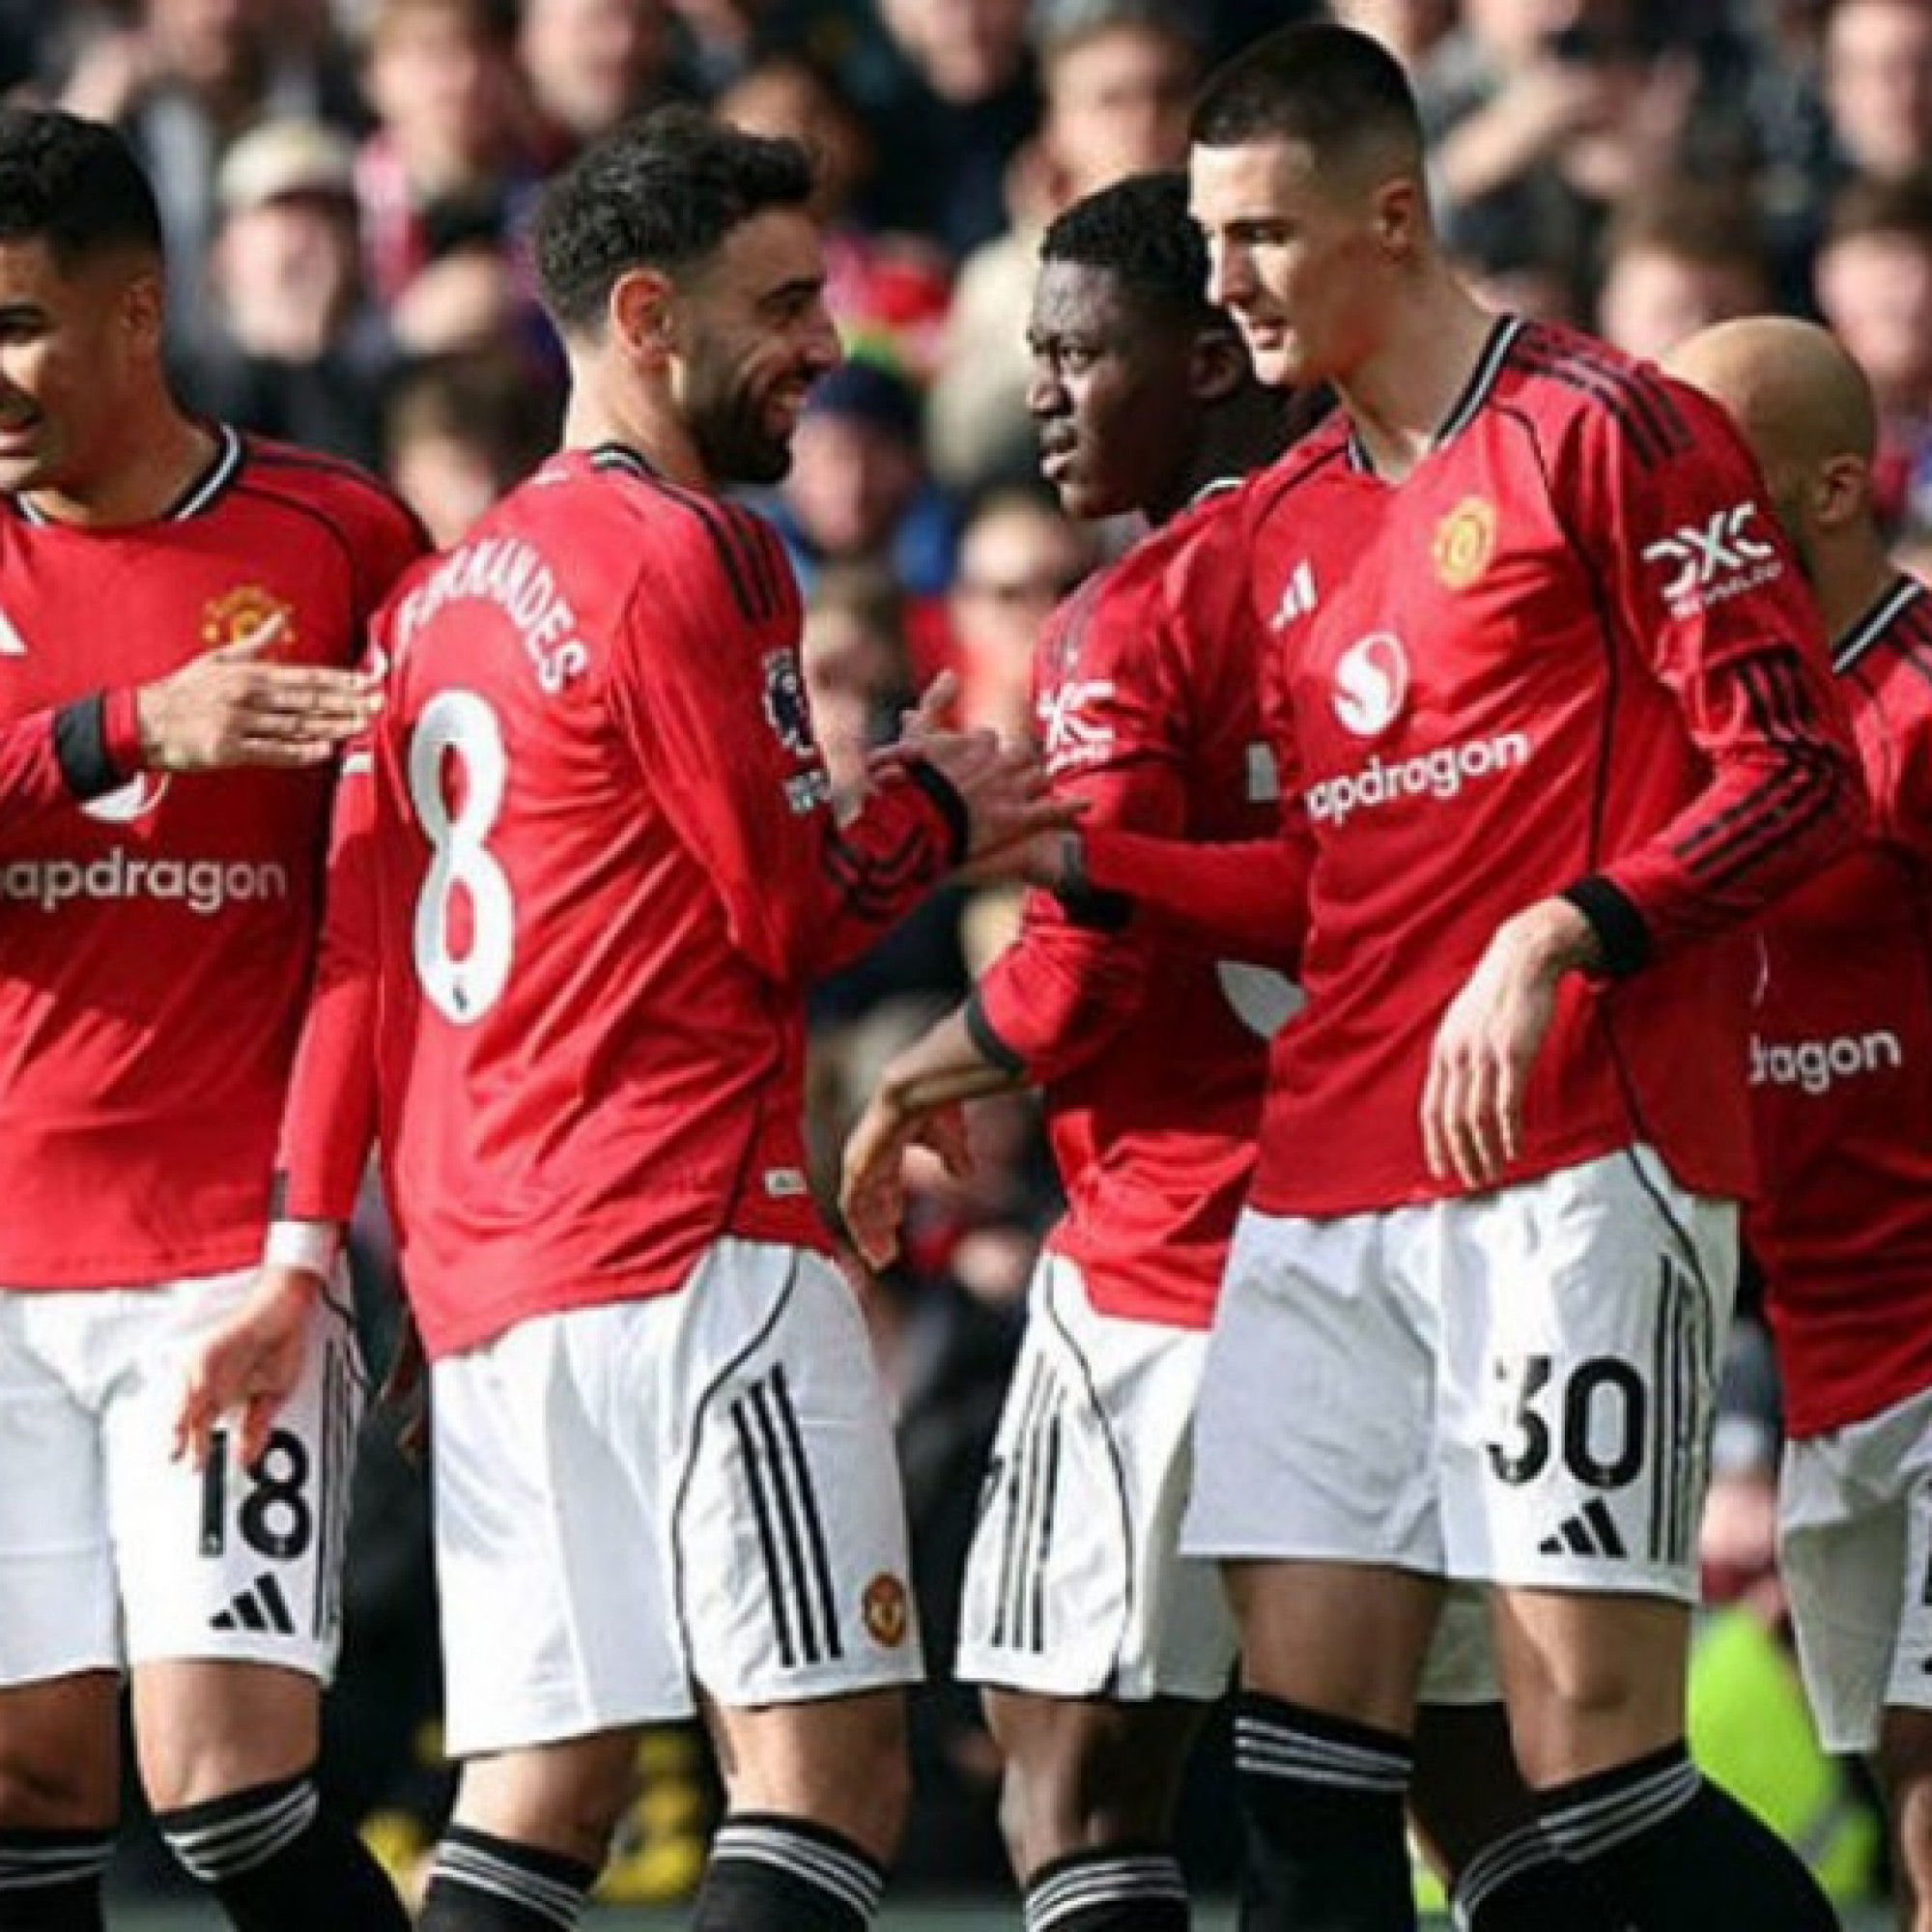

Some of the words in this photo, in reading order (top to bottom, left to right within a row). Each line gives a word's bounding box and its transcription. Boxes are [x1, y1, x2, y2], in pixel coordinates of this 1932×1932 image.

[2, 844, 287, 914] apdragon
[410, 689, 516, 1026] 8
[1486, 1354, 1646, 1490] 30
[199, 1429, 312, 1563] 18
